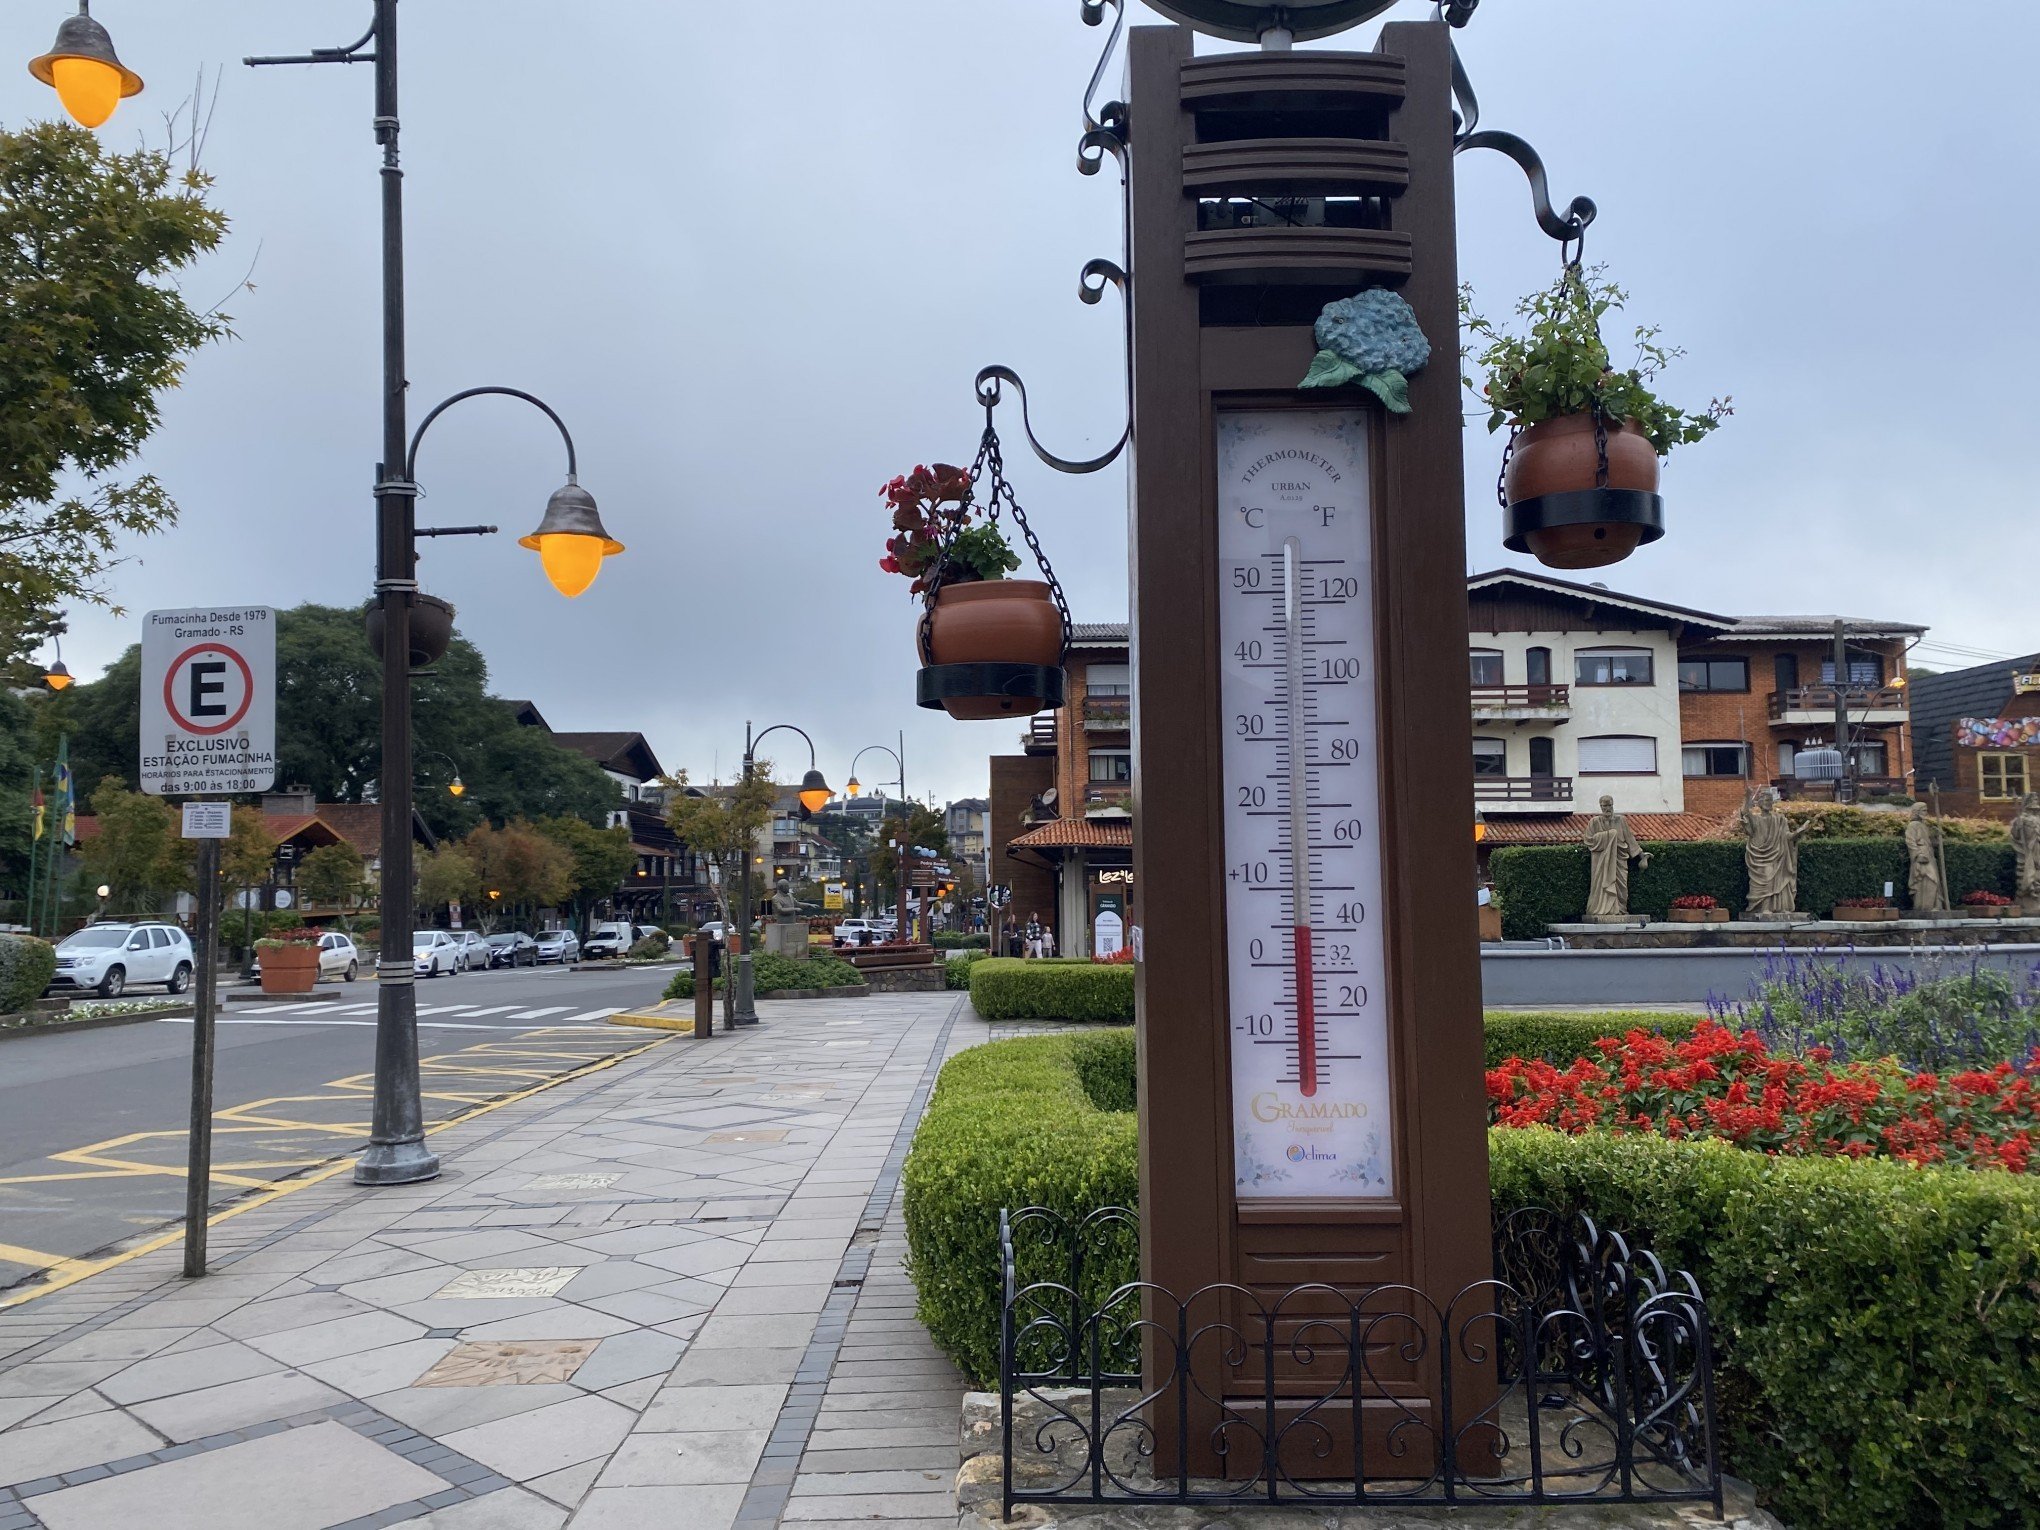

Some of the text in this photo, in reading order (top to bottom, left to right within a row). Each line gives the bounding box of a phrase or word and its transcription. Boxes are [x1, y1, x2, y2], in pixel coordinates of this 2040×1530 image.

[1241, 449, 1341, 484] THERMOMETER
[1271, 482, 1311, 491] URBAN
[1233, 567, 1260, 588] 50
[1319, 577, 1358, 599] 120
[152, 610, 267, 625] Fumacinha Desde 1979
[174, 627, 220, 638] Gramado
[229, 626, 244, 636] RS
[1234, 640, 1262, 661] 40
[1320, 658, 1360, 679] 100
[190, 662, 227, 717] E
[1236, 714, 1264, 735] 30
[166, 737, 250, 753] EXCLUSIVO
[1331, 738, 1359, 760] 80
[143, 752, 272, 769] ESTAÇÃO FUMACINHA
[141, 767, 274, 780] HORÁRIOS PARA ESTACIONAMENTO
[160, 779, 256, 793] das 9:00 às 18:00
[1238, 786, 1266, 807] 20
[1334, 819, 1362, 840] 60
[1228, 862, 1268, 883] +10
[1336, 902, 1365, 924] 40
[1250, 938, 1263, 960] 0
[1330, 944, 1351, 960] 32
[1339, 985, 1368, 1008] 20
[1235, 1014, 1273, 1036] -10
